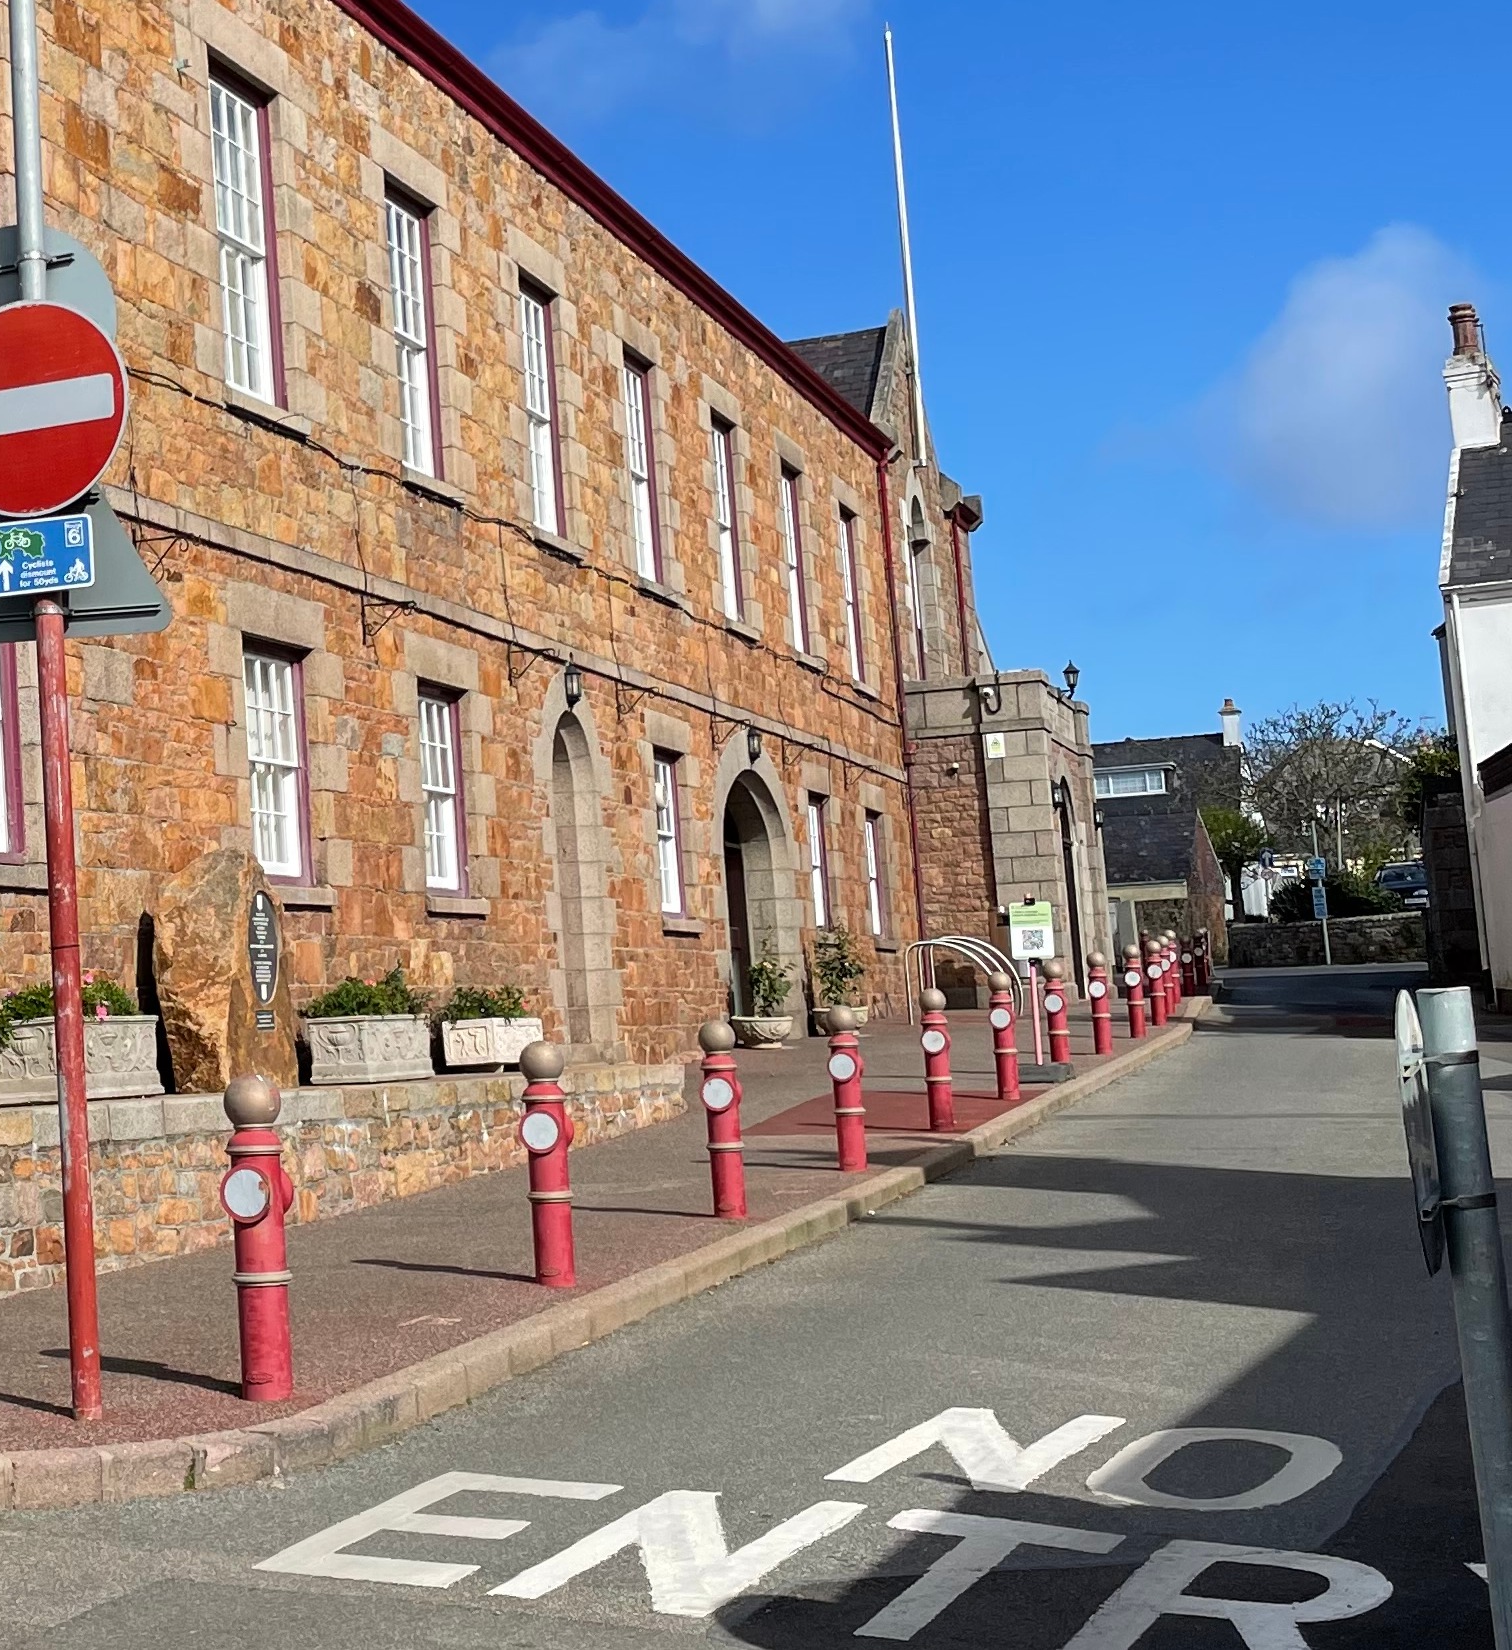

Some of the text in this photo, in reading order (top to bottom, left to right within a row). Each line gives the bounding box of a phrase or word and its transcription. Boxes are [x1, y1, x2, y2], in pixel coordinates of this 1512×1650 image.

[68, 529, 80, 544] 6
[21, 560, 54, 570] Cyclists
[20, 568, 56, 579] dismount
[824, 1407, 1345, 1512] NO
[253, 1471, 1488, 1650] ENTR
